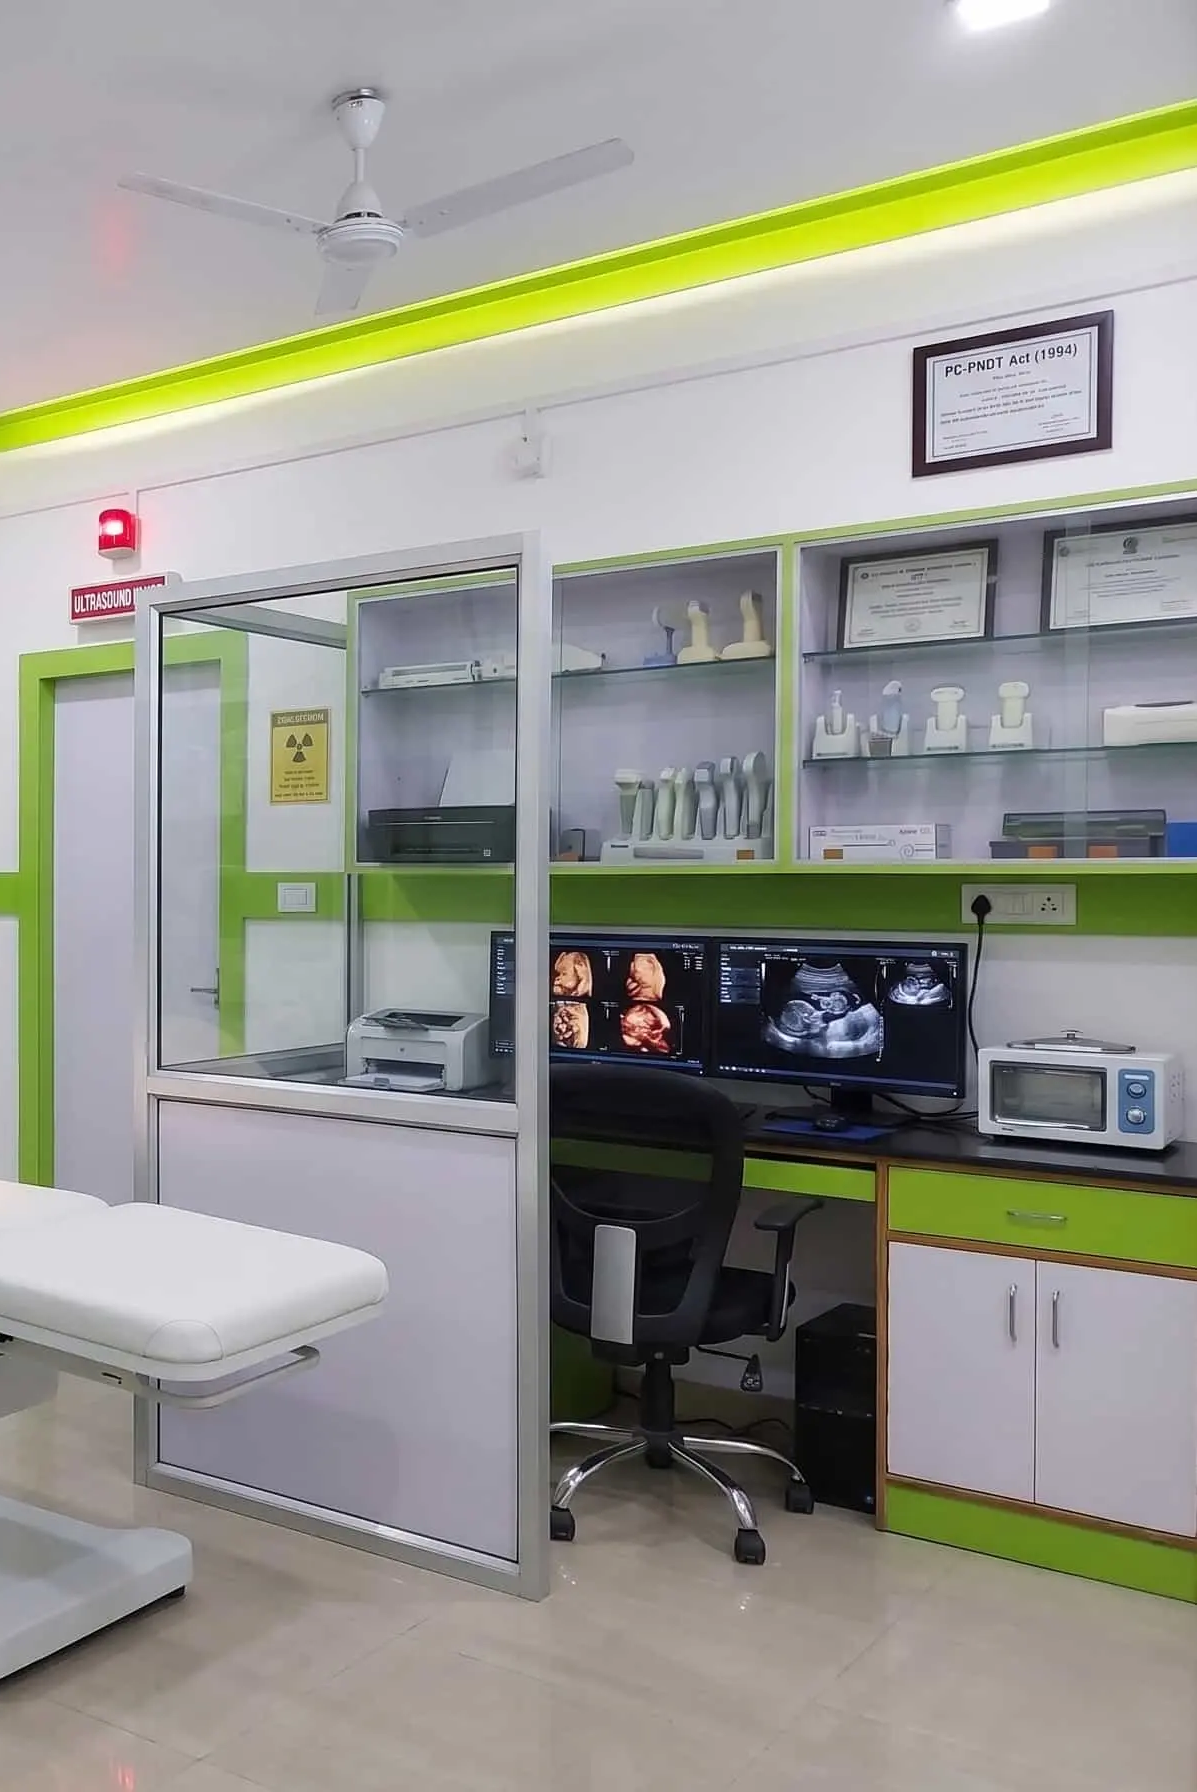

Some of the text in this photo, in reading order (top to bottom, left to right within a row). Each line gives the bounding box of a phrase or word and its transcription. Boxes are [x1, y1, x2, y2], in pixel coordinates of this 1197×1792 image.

[945, 356, 1003, 378] PC-PNDT
[1009, 352, 1030, 368] Act
[1034, 343, 1077, 365] (1994)
[74, 588, 132, 613] ULTRASOUND
